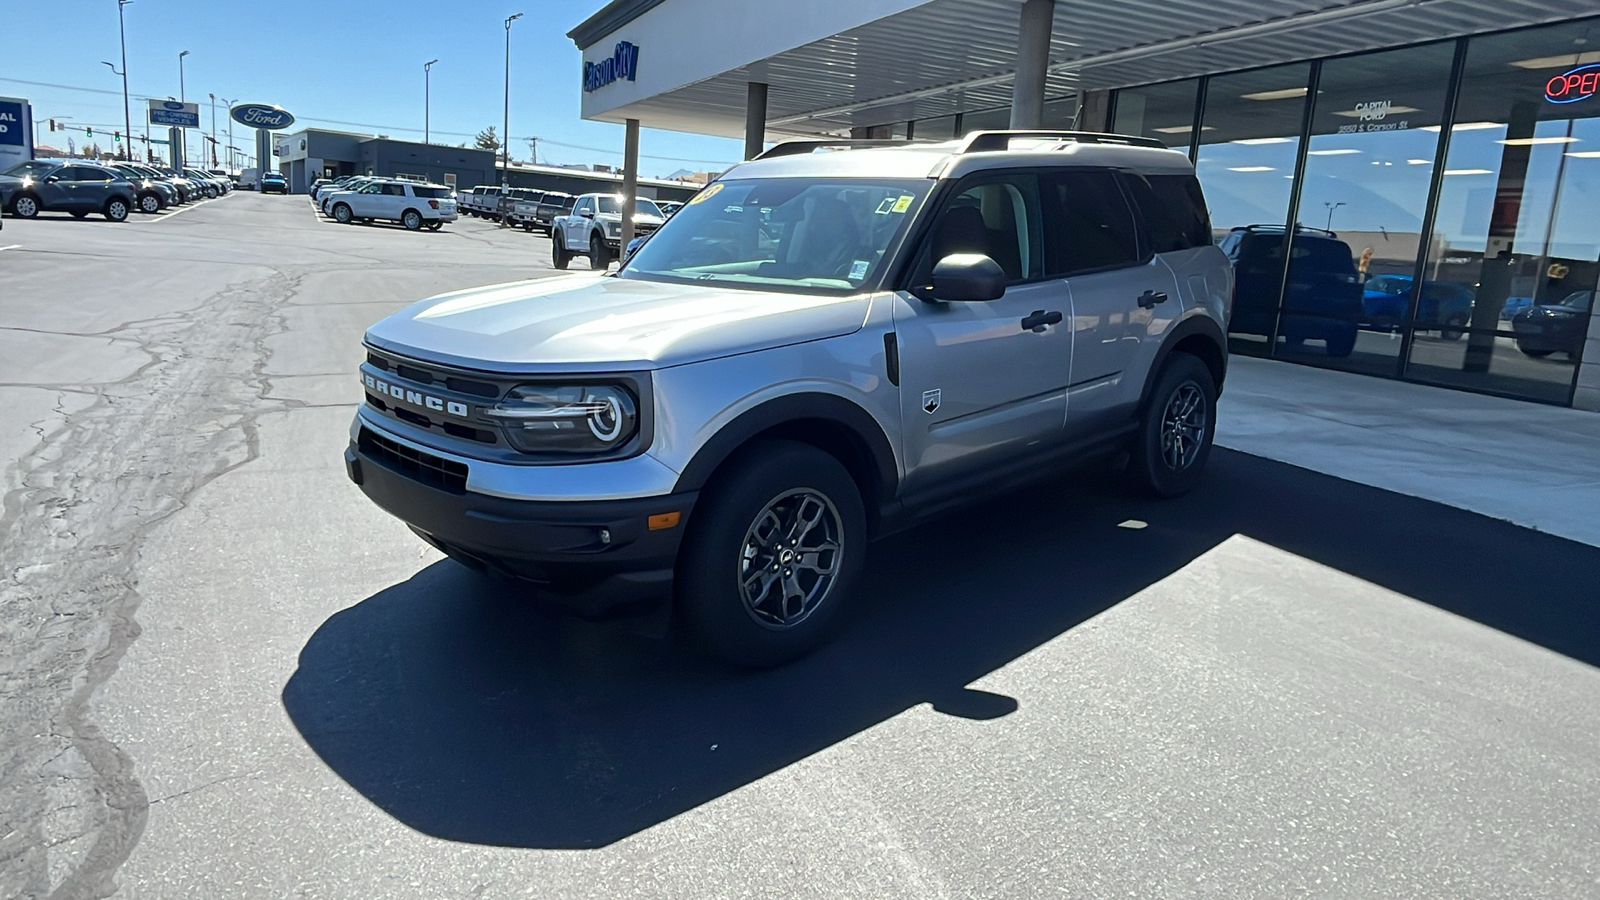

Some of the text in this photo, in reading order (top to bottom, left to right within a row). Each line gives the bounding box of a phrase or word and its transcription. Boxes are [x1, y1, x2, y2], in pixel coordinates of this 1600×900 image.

[584, 40, 639, 93] Carson City
[1355, 100, 1392, 112] CAPITAL
[153, 110, 195, 120] PRE-OWNED
[158, 116, 191, 125] VEHICLES
[244, 107, 282, 126] Ford
[1359, 110, 1387, 122] FORD
[1358, 124, 1365, 132] S
[1367, 123, 1397, 132] Carson
[364, 376, 468, 416] BRONCO
